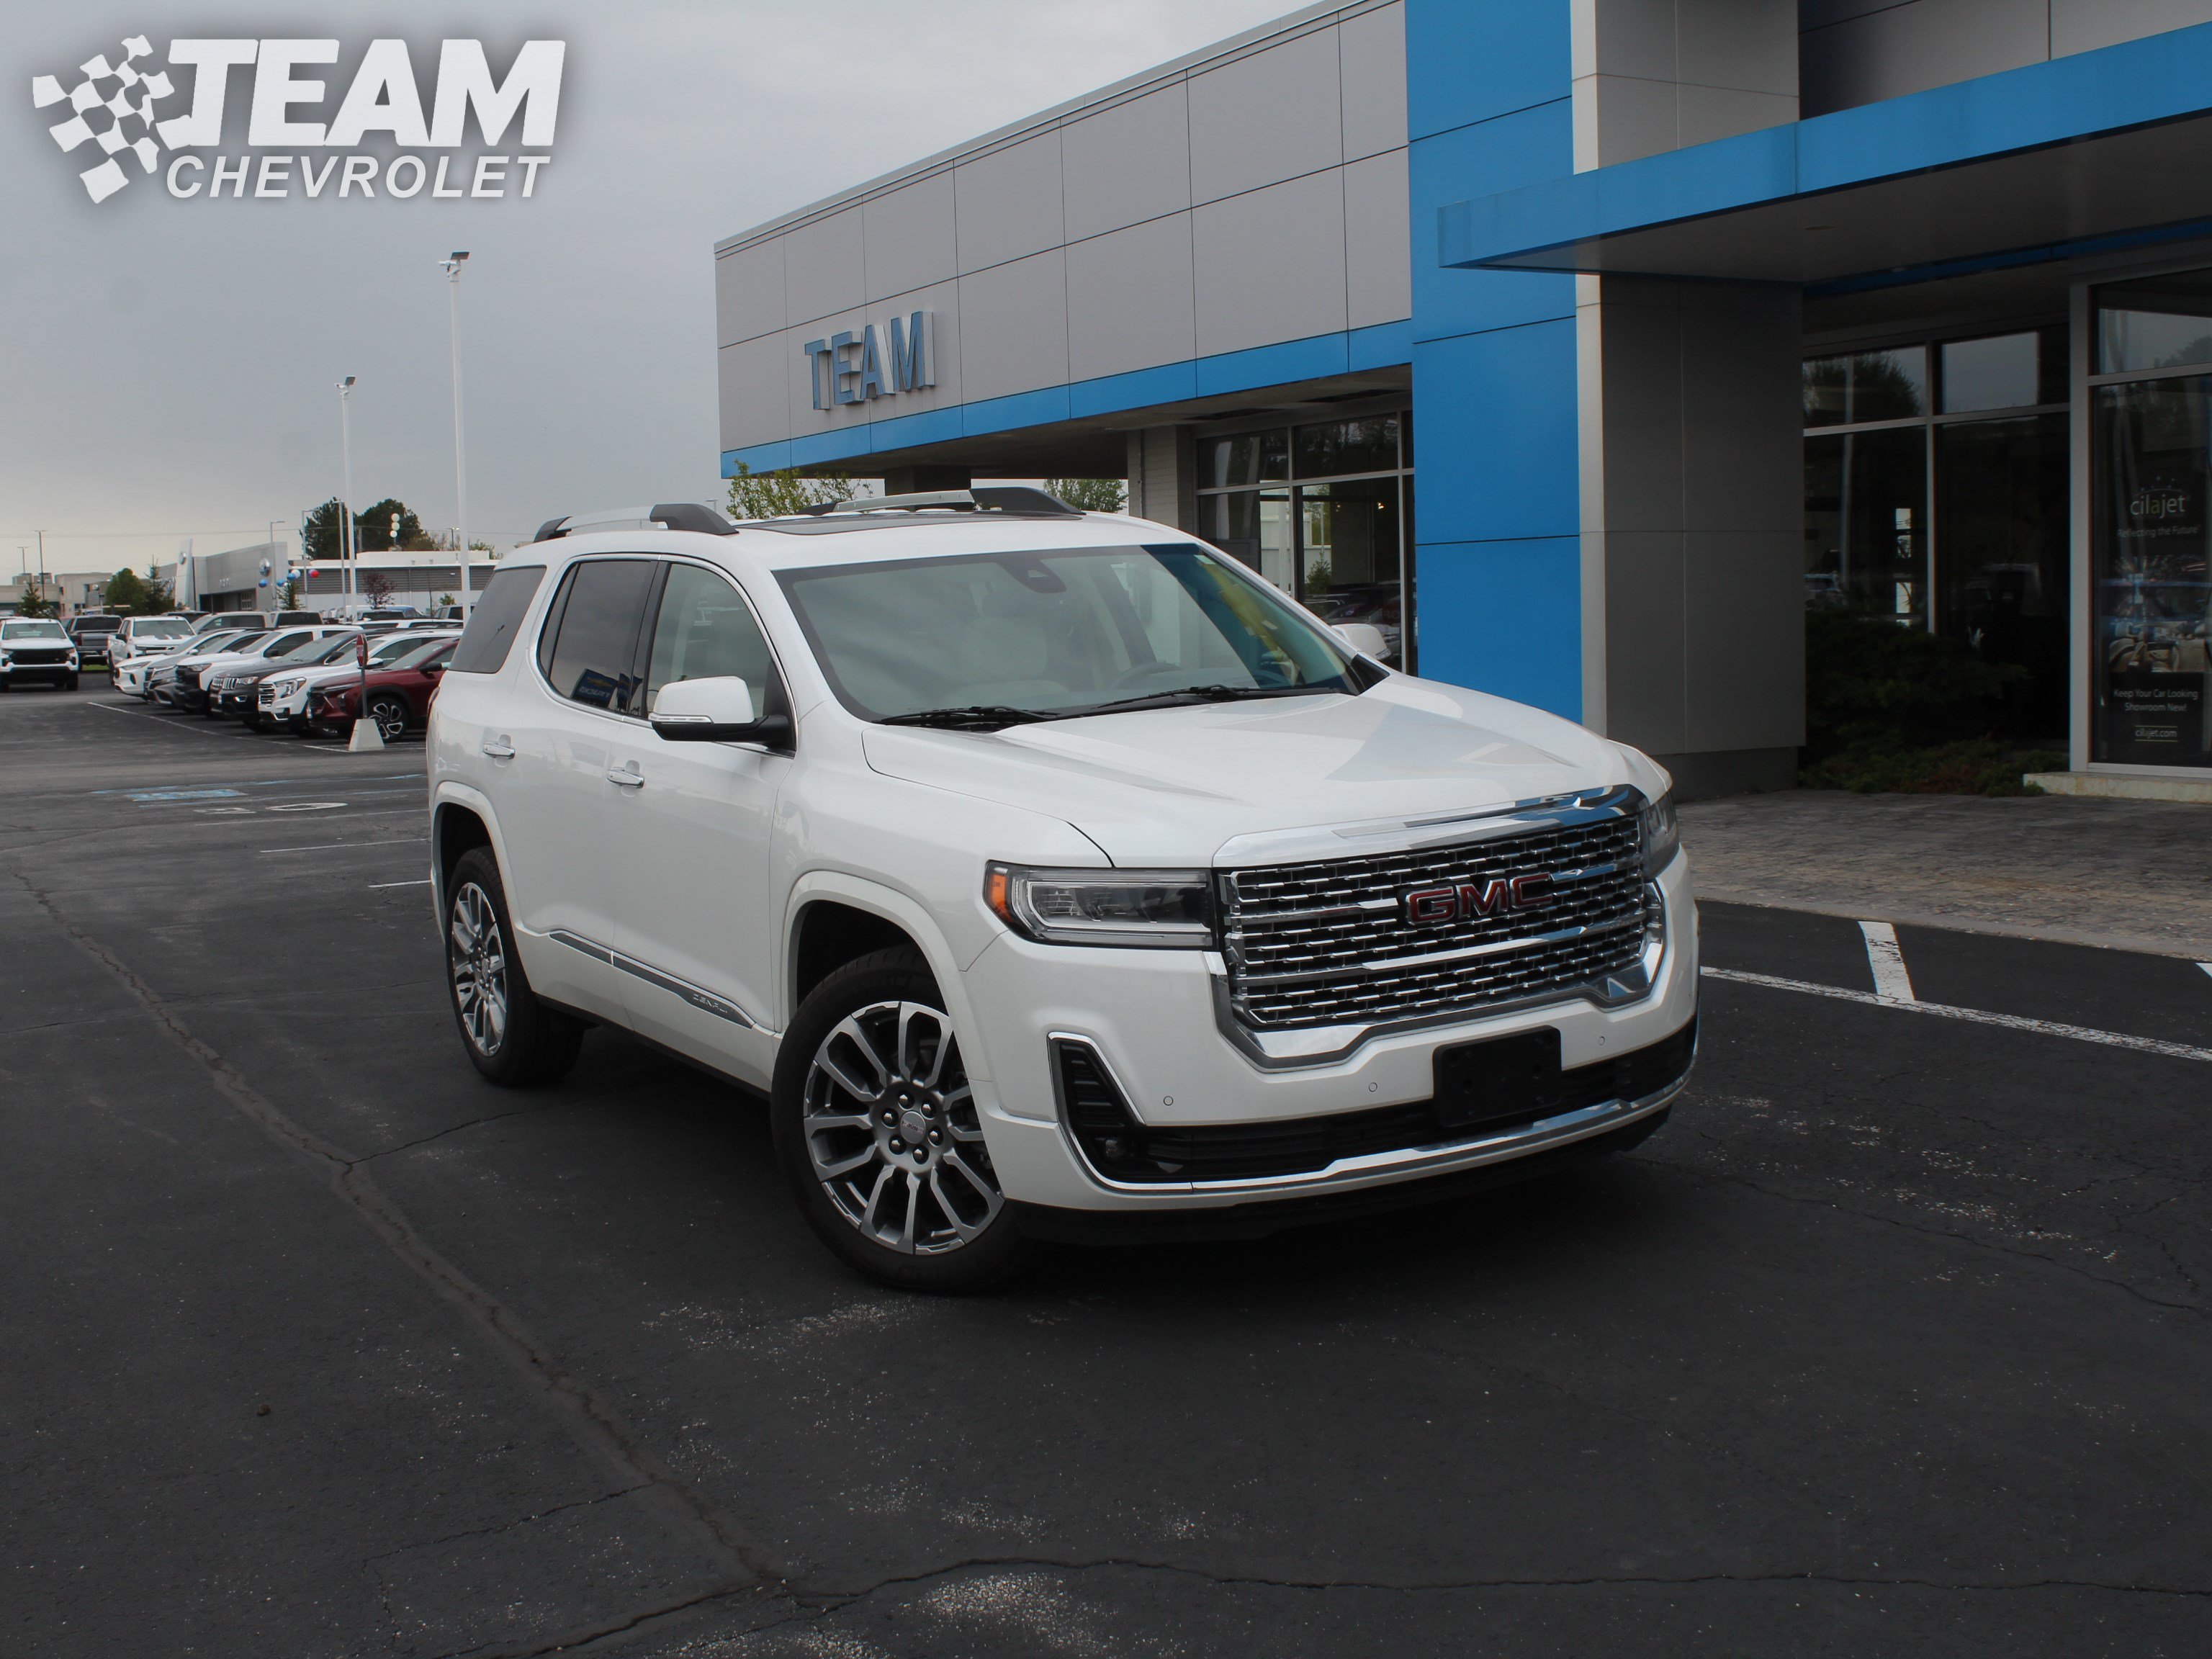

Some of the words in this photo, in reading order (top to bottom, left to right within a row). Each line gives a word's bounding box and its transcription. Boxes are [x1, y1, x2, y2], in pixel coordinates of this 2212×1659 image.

[804, 311, 935, 410] TEAM
[2130, 493, 2186, 518] cilajet
[2157, 526, 2171, 536] the
[2113, 688, 2133, 698] Keep
[2135, 688, 2152, 698] Your
[2153, 688, 2167, 698] Car
[2168, 688, 2198, 700] Looking
[2124, 702, 2165, 711] Showroom
[2167, 702, 2187, 711] New!
[2135, 727, 2177, 739] cilajet.com
[1406, 871, 1555, 926] GMC
